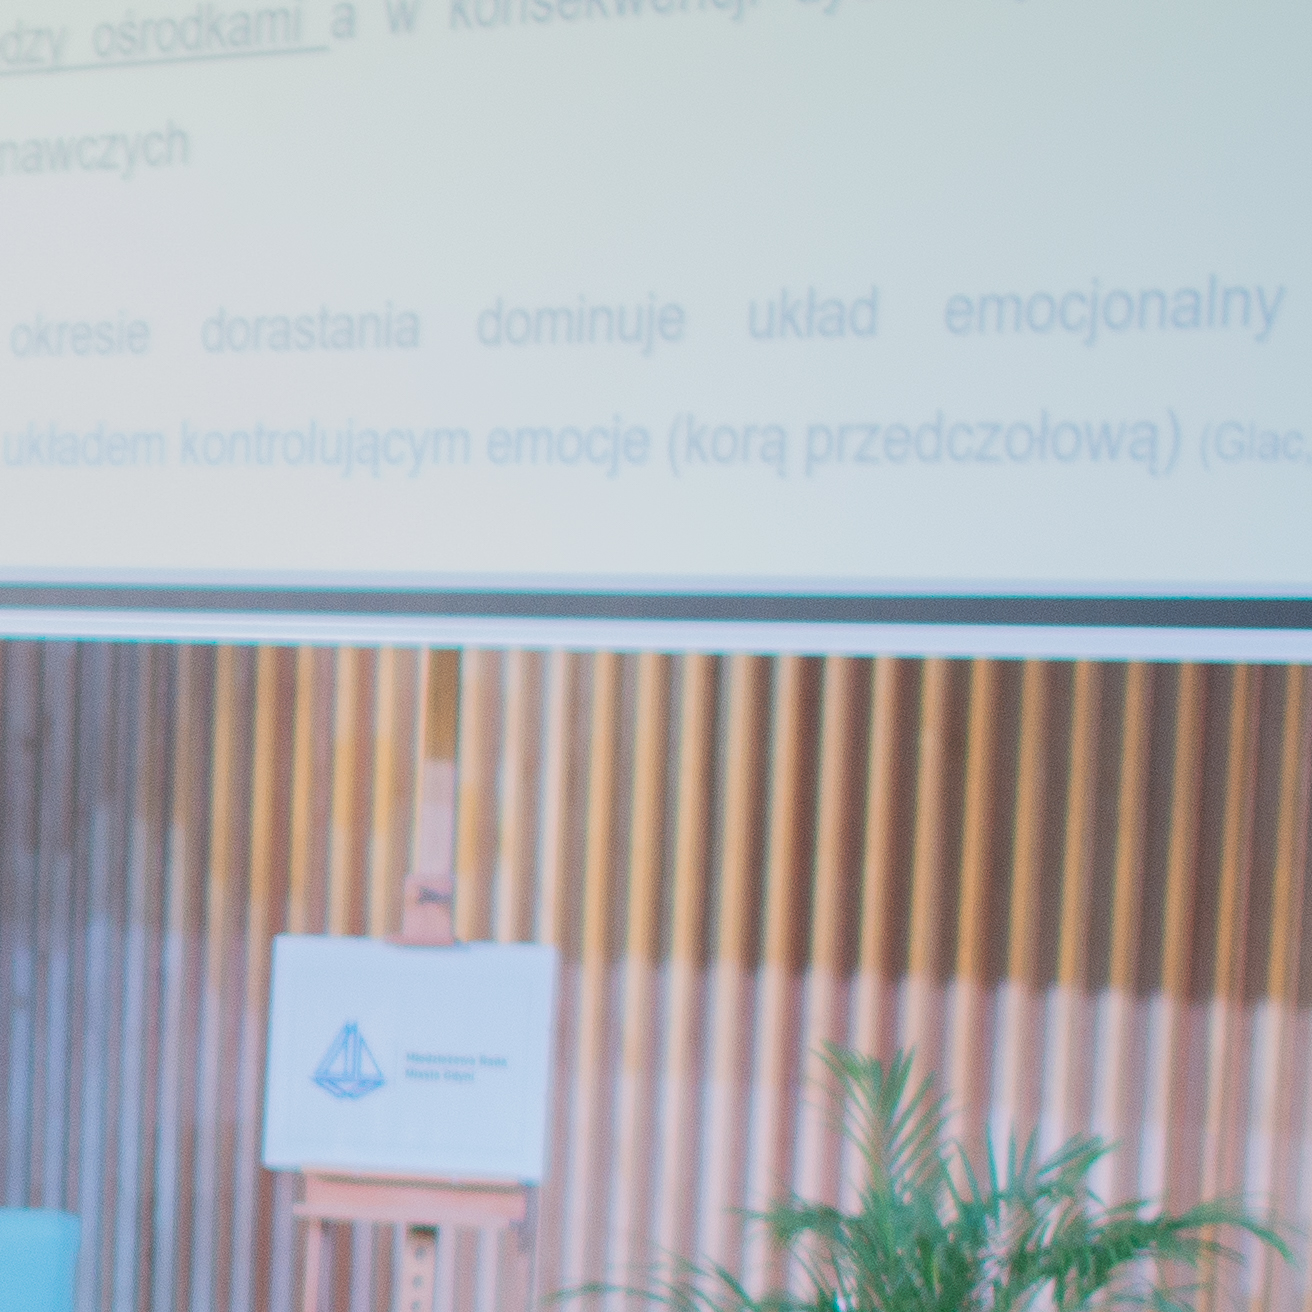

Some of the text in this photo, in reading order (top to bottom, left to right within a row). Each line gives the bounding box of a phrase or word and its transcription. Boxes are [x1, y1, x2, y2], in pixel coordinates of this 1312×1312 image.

[92, 1, 304, 59] ośrodkami
[331, 0, 358, 40] a
[8, 307, 152, 359] okresie
[200, 300, 422, 355] dorastania
[476, 293, 687, 357] dominuje
[748, 284, 880, 343] układ
[943, 272, 1287, 348] emocjonalny
[2, 419, 166, 469] układem
[180, 417, 473, 480] kontrolującym
[485, 412, 653, 480] emocje
[666, 411, 790, 481] (korą
[803, 405, 1184, 481] przedczołową)
